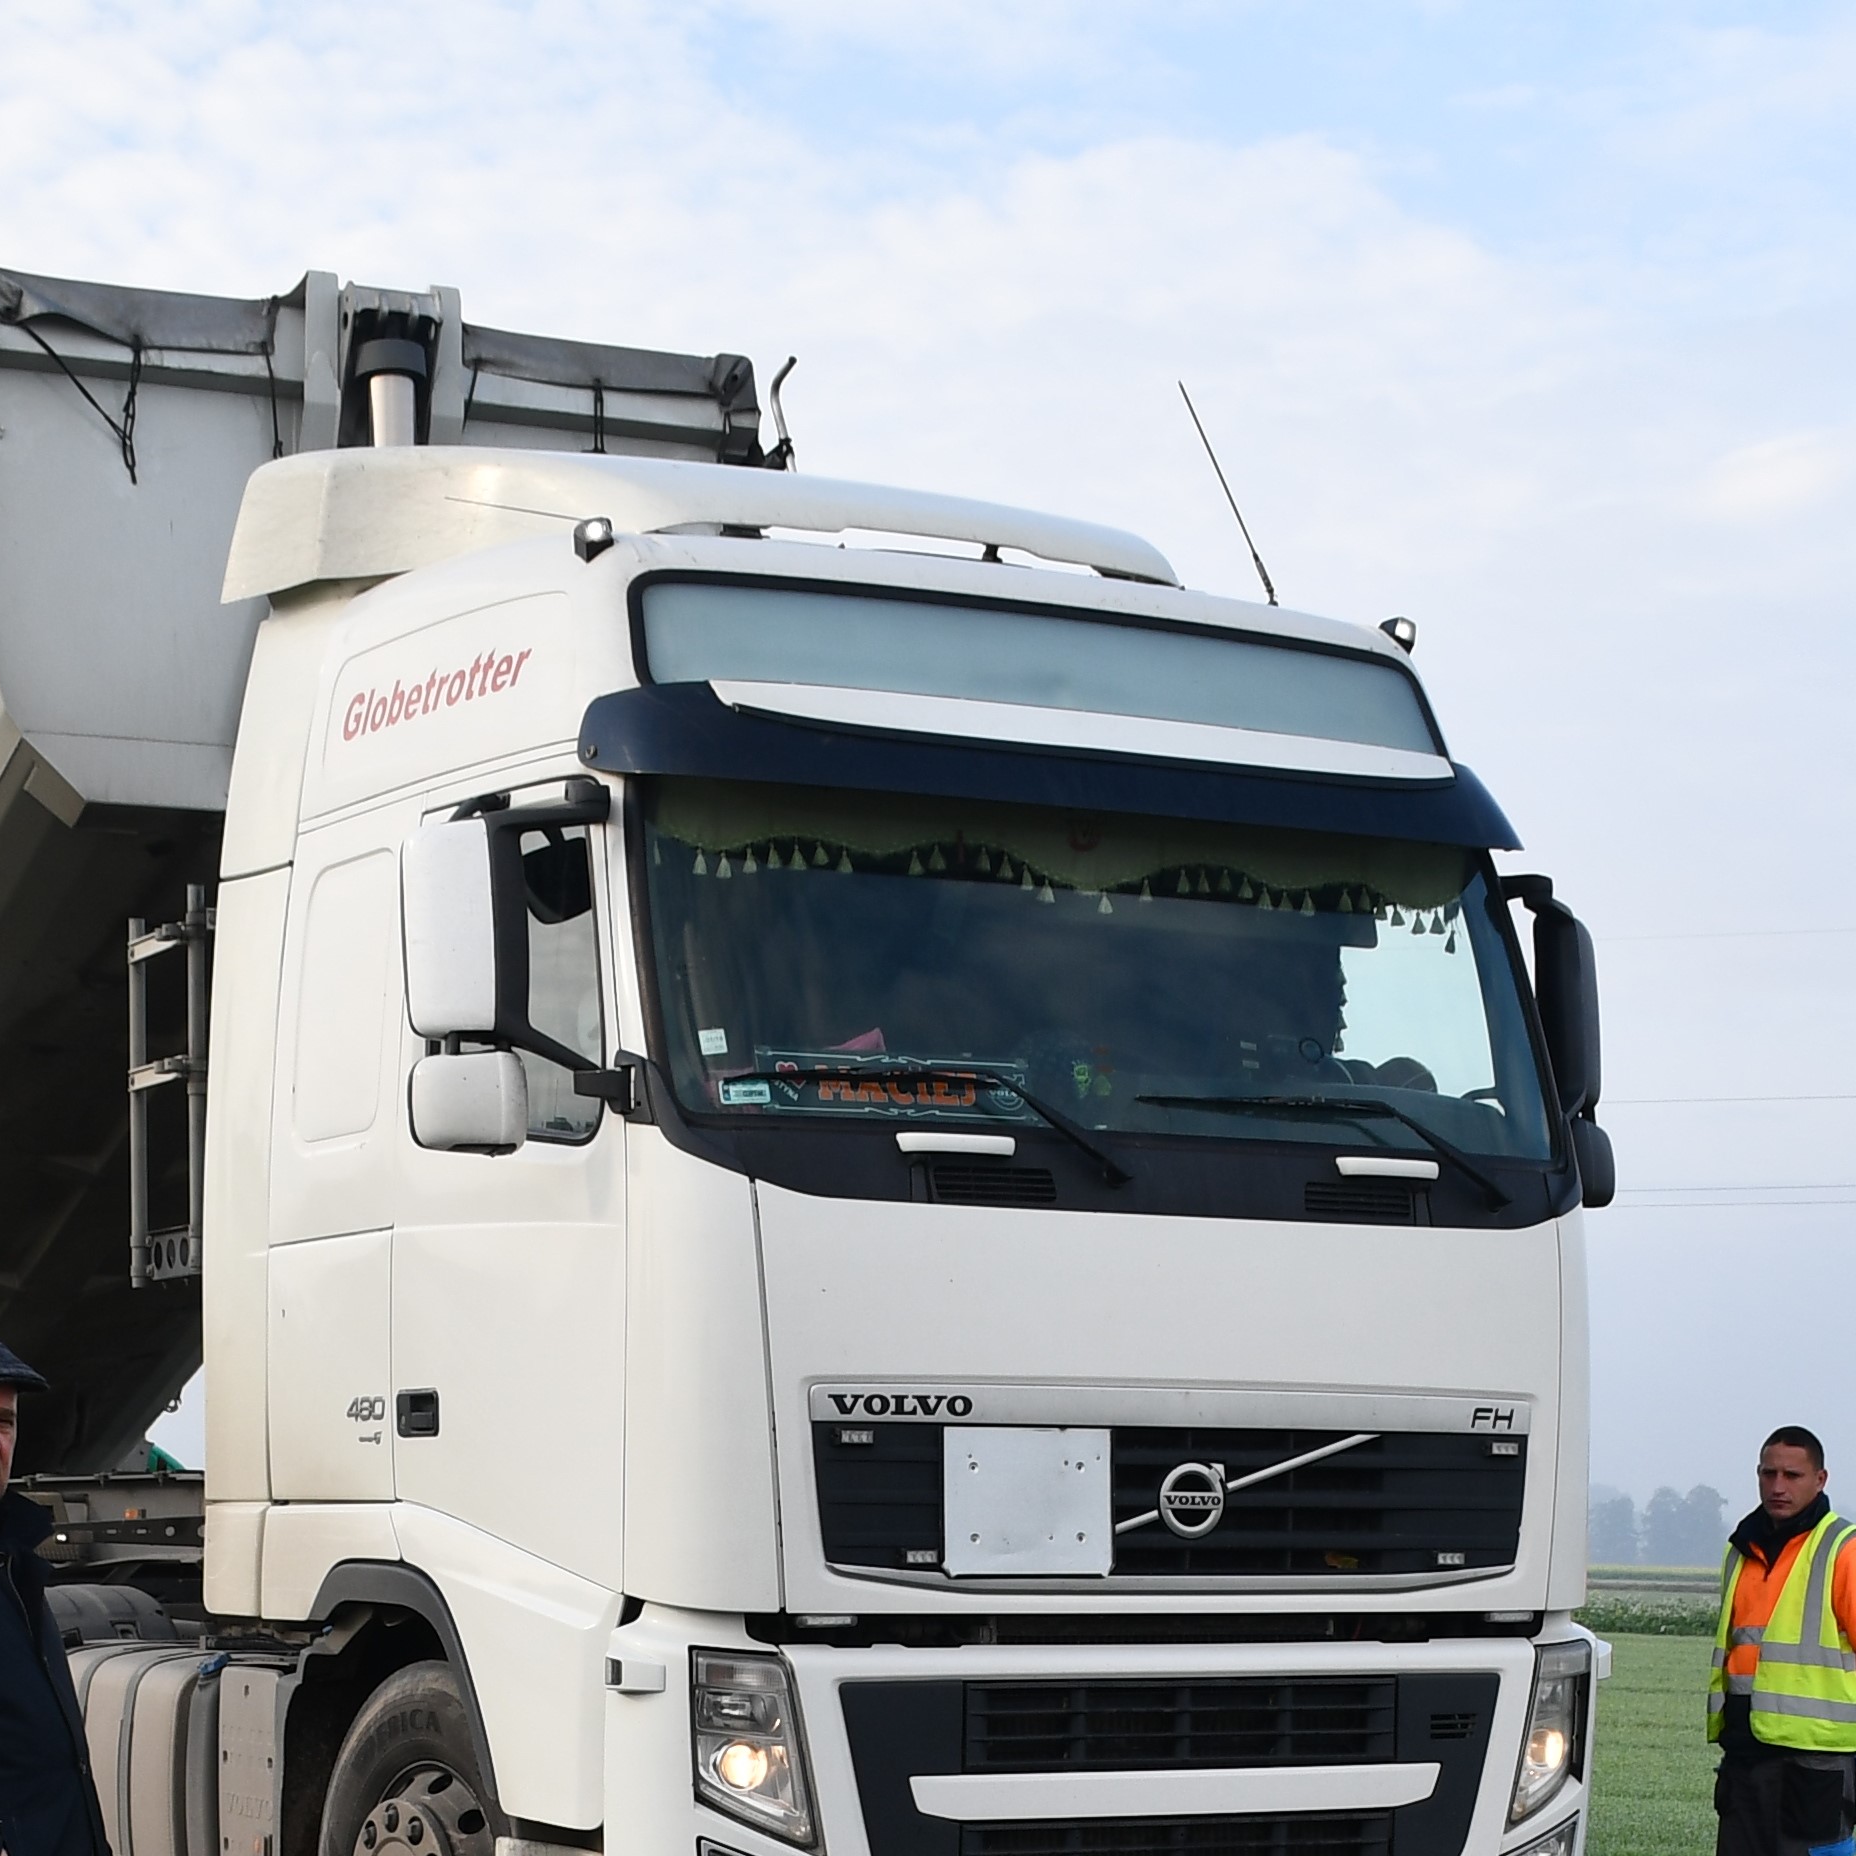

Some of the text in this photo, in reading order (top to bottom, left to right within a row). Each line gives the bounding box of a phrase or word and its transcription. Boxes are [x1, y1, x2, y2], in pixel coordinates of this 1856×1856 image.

[343, 648, 532, 741] Globetrotter
[347, 1396, 385, 1423] 480
[828, 1394, 974, 1418] VOLVO
[1471, 1406, 1516, 1430] FH
[1163, 1493, 1223, 1508] VOLVO
